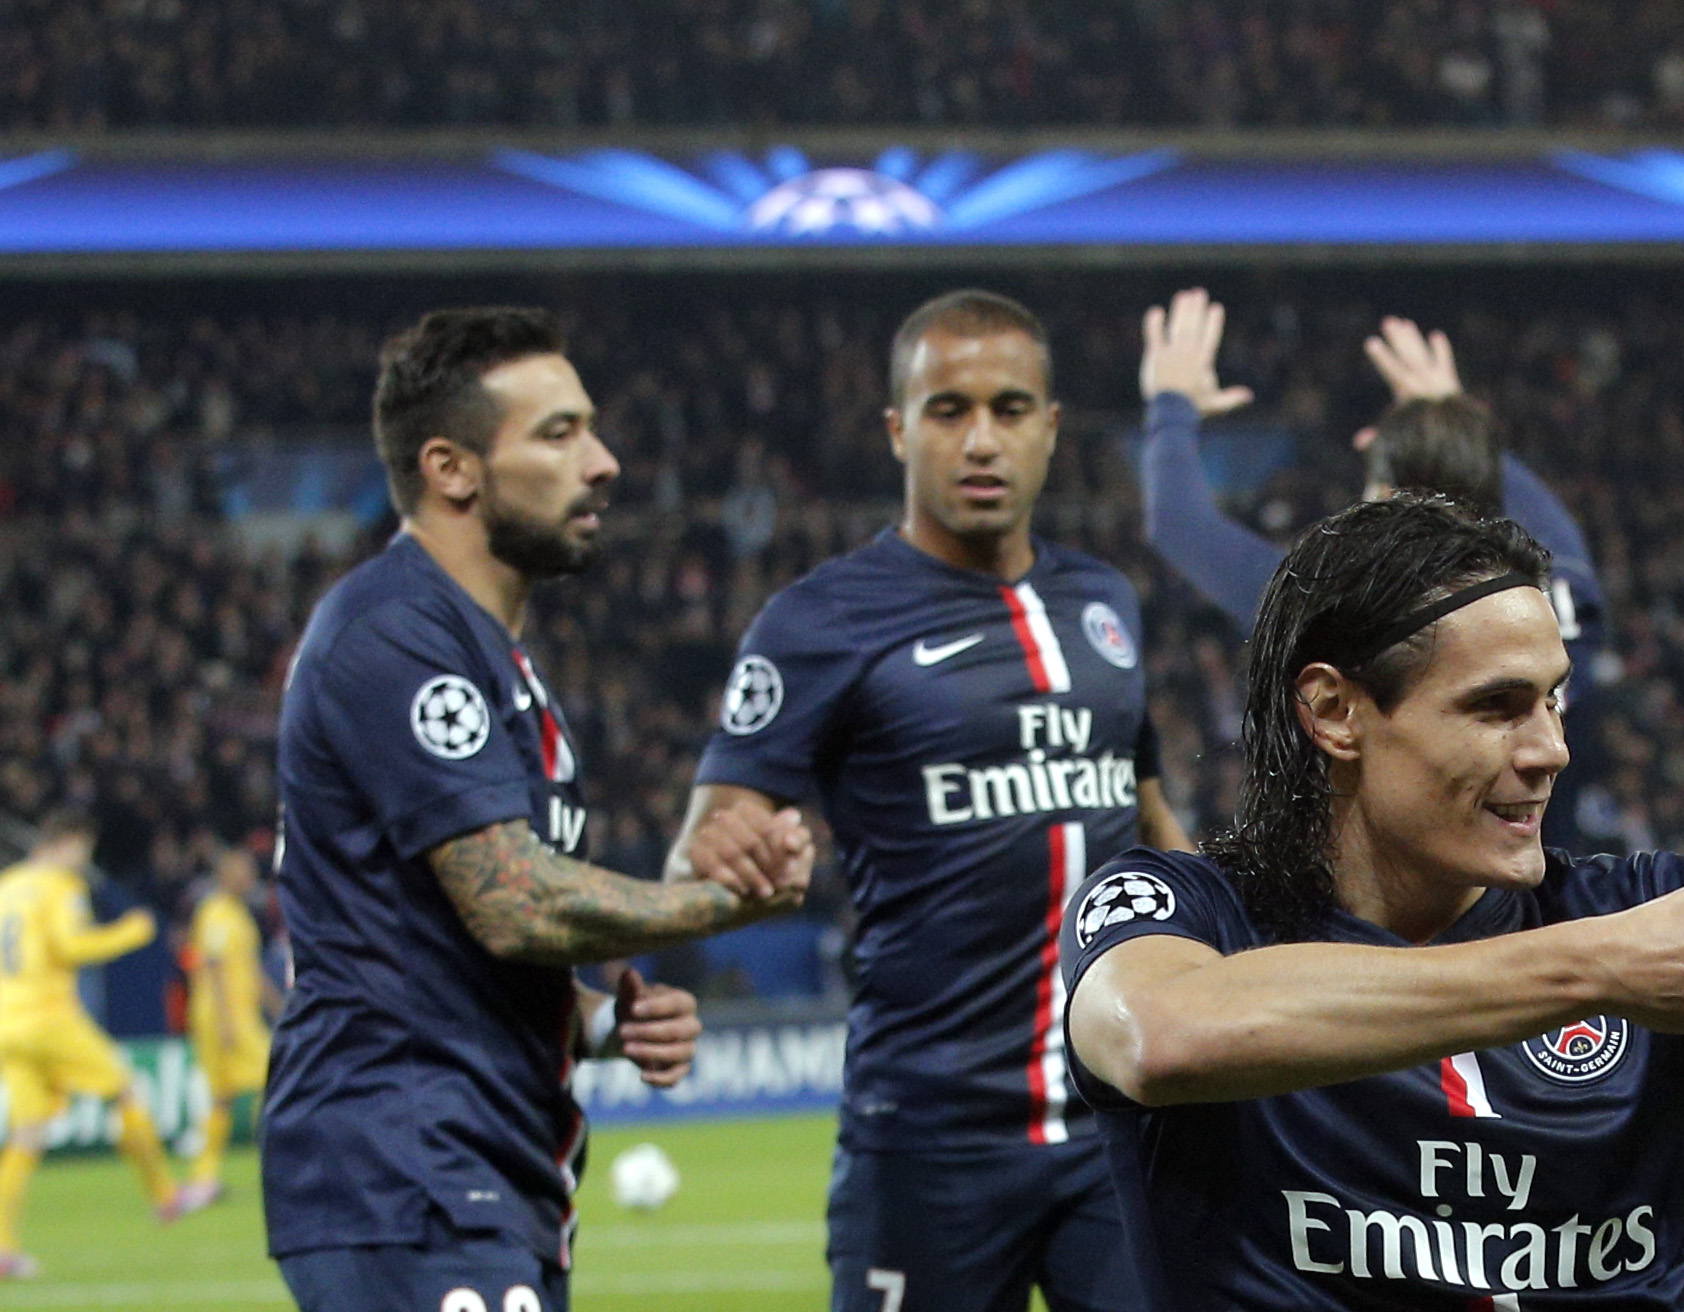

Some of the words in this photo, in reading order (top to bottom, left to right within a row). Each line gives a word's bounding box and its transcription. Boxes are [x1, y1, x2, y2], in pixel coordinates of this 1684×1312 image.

[1016, 702, 1093, 753] Fly
[921, 748, 1137, 825] Emirate
[548, 795, 586, 853] ly
[1537, 1030, 1621, 1075] SAINT-GERMAIN
[1416, 1139, 1537, 1211] Fly
[1281, 1189, 1656, 1291] Emirates
